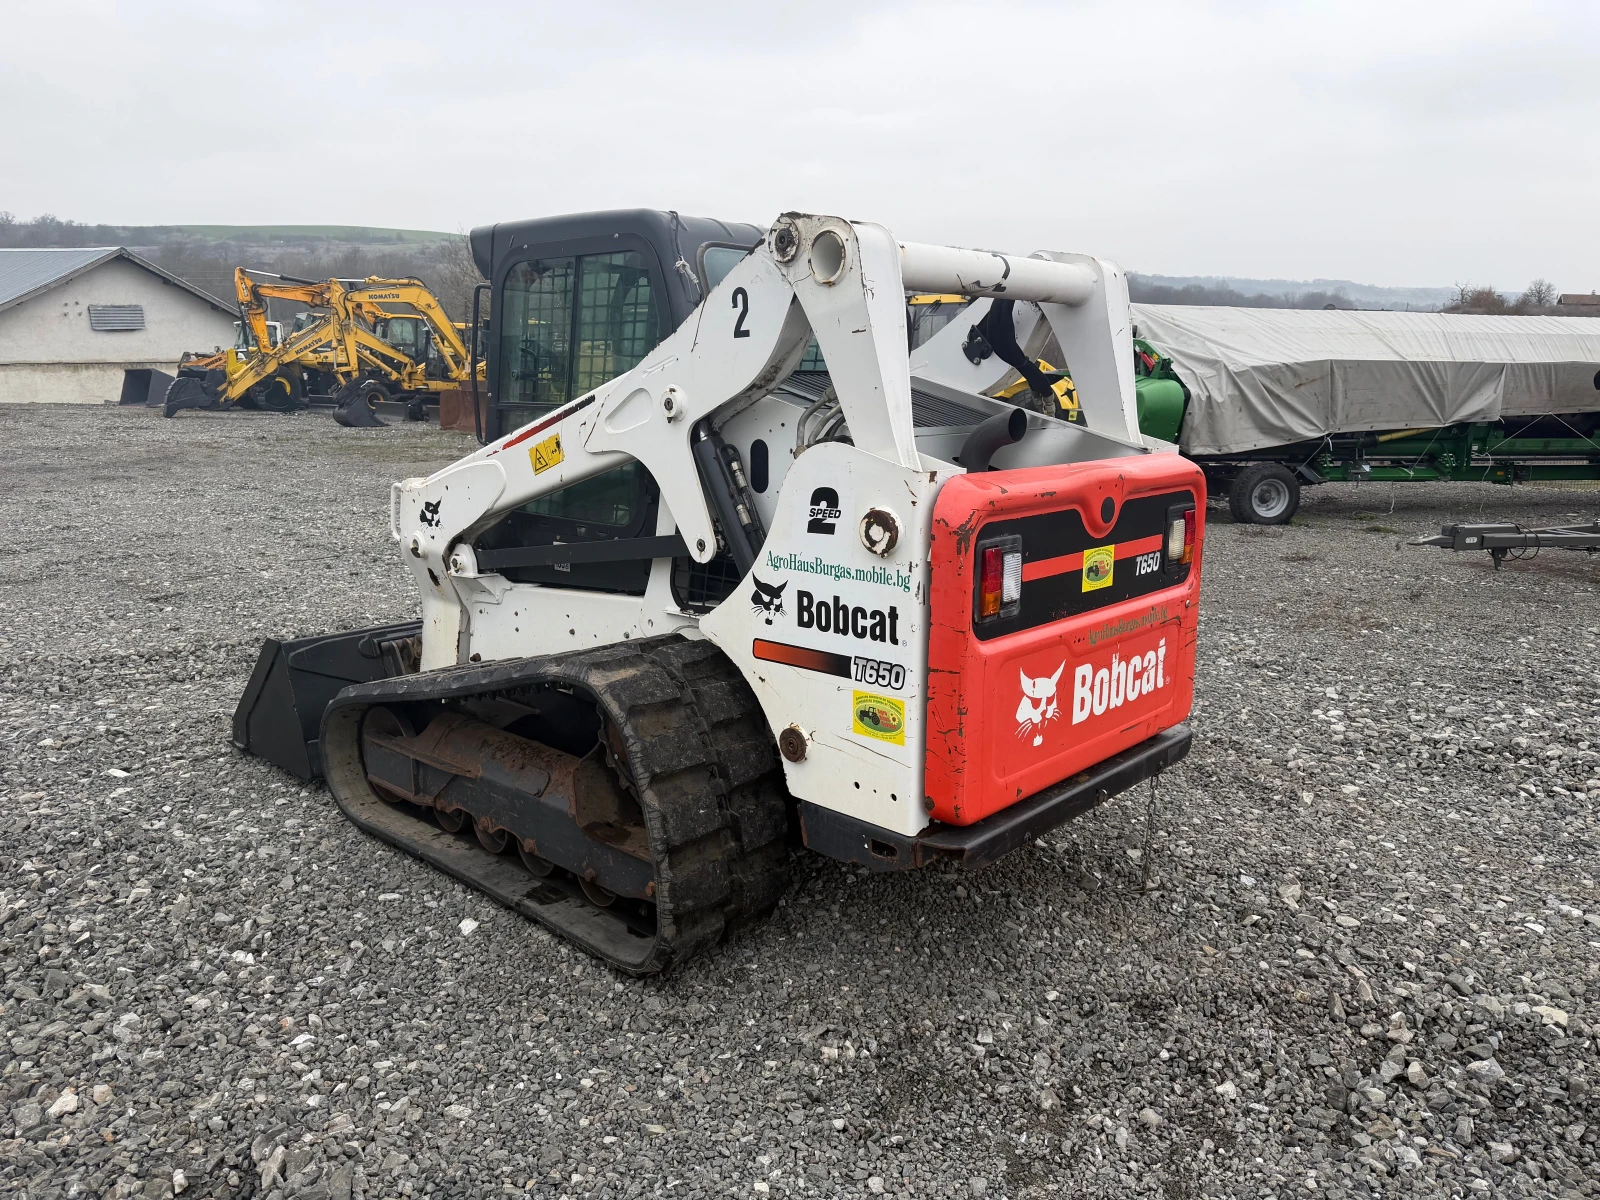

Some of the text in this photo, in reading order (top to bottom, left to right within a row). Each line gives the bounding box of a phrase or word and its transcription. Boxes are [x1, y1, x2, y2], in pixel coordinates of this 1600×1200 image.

[368, 292, 400, 300] KOMATSU
[731, 287, 750, 338] 2
[294, 338, 323, 355] KOMATSU
[807, 487, 839, 535] 2
[808, 508, 842, 519] SPEED
[766, 550, 910, 592] AgroHausBurgas.mobile.bg
[1135, 552, 1161, 576] T650
[797, 590, 899, 646] Bobcat
[853, 656, 906, 691] T650
[1072, 637, 1167, 725] Bobcat
